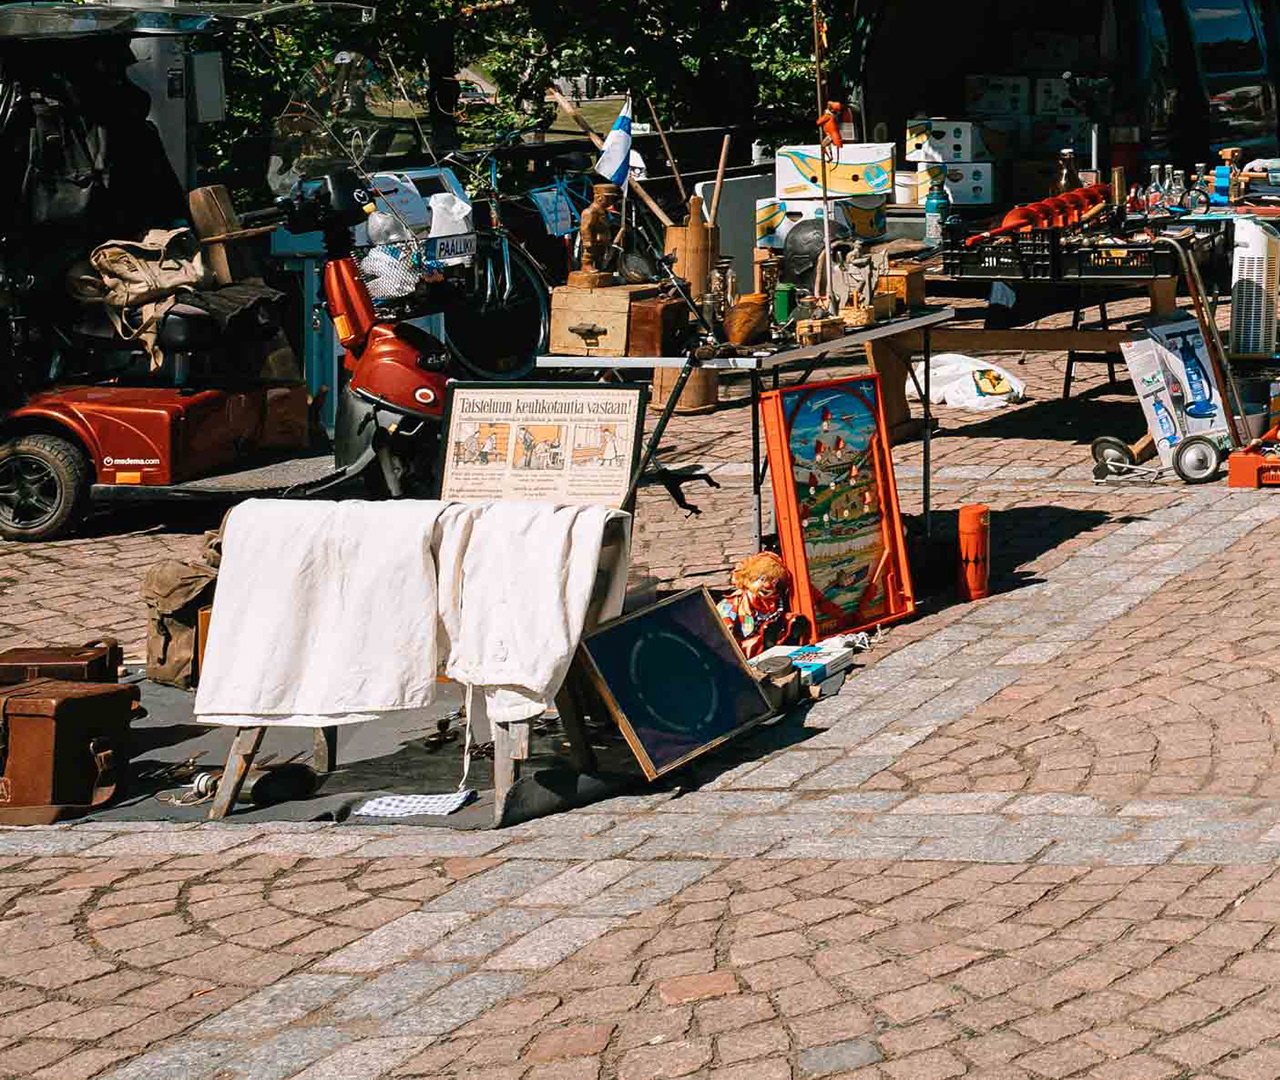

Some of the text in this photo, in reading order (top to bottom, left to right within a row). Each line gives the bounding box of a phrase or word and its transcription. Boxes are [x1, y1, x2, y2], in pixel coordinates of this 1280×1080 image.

[459, 397, 632, 415] Taisteluun keuhkotautia vastaan!
